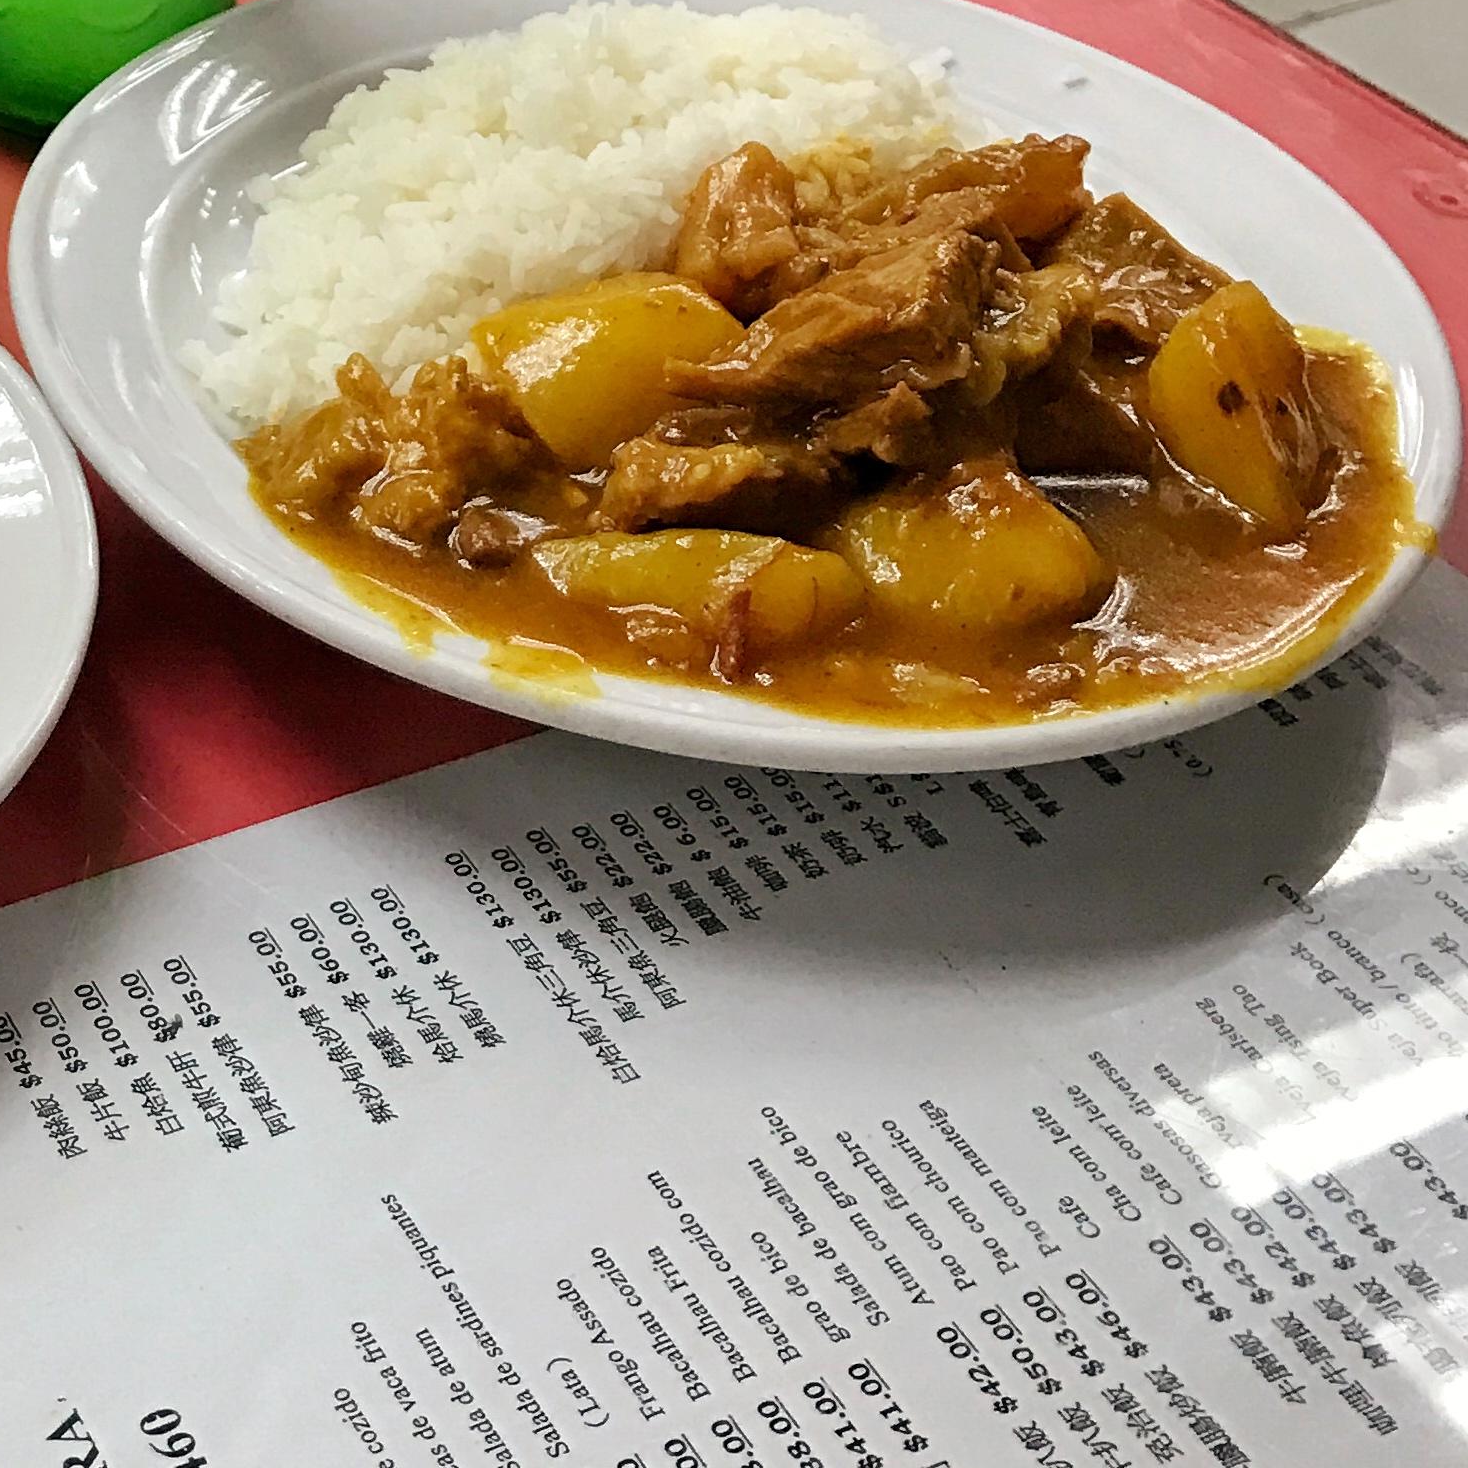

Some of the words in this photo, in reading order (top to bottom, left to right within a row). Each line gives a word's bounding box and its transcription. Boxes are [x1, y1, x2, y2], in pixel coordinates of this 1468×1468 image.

[686, 786, 750, 850] $15.00
[723, 773, 788, 837] $15.00
[525, 826, 588, 894] $55.00
[571, 822, 634, 889] $22.00
[610, 810, 673, 876] $22.00
[444, 850, 515, 929] $130.00
[491, 846, 562, 925] $130.00
[290, 913, 350, 985] $60.00
[329, 897, 398, 980] $130.00
[370, 884, 440, 965] $130.00
[163, 954, 221, 1028] $55.00
[248, 927, 307, 999] $55.00
[32, 997, 89, 1074] $50.00
[74, 980, 139, 1068] $100.00
[75, 1077, 130, 1141] 牛片飯
[1067, 1084, 1107, 1124] leite
[1087, 1050, 1156, 1117] diversas
[1153, 1062, 1205, 1106] preta
[761, 1106, 798, 1146] bico
[793, 1145, 818, 1168] de
[881, 1119, 950, 1193] chourico
[918, 1099, 993, 1177] manteiga
[1031, 1105, 1072, 1145] leite
[1100, 1123, 1143, 1161] com
[647, 1170, 683, 1209] com
[814, 1170, 858, 1209] grao
[835, 1130, 910, 1210] fiambre
[1068, 1144, 1107, 1182] com
[1140, 1163, 1183, 1206] Cafe
[747, 1157, 817, 1238] bacalhau
[947, 1195, 985, 1234] com
[988, 1179, 1027, 1217] com
[1058, 1195, 1101, 1239] Cafe
[1105, 1184, 1142, 1222] Cha
[1272, 1185, 1357, 1271] $43.00
[1311, 1171, 1398, 1254] $43.00
[380, 1194, 455, 1280] piquantes
[679, 1213, 732, 1273] cozido
[750, 1231, 788, 1275] bico
[812, 1237, 837, 1260] de
[849, 1212, 888, 1252] com
[905, 1211, 944, 1251] com
[982, 1237, 1020, 1276] Pao
[1024, 1220, 1062, 1259] Pao
[1189, 1217, 1275, 1305] $43.00
[1230, 1207, 1316, 1289] $42.00
[590, 1246, 643, 1307] cozido
[647, 1245, 689, 1293] Frita
[784, 1274, 810, 1297] de
[833, 1262, 891, 1327] Salada
[884, 1253, 935, 1305] Atum
[940, 1254, 977, 1292] Pao
[1148, 1234, 1233, 1323] $43.00
[350, 1321, 387, 1363] frito
[441, 1281, 504, 1358] sardines
[556, 1278, 615, 1344] Assado
[683, 1292, 758, 1384] Bacalhau
[727, 1275, 803, 1365] Bacalhau
[806, 1300, 852, 1344] grao
[1022, 1285, 1105, 1377] $43.00
[1065, 1268, 1149, 1359] $46.00
[415, 1327, 456, 1377] atum
[497, 1361, 521, 1386] de
[638, 1309, 711, 1402] Bacalhau
[936, 1321, 1018, 1415] $42.00
[979, 1304, 1063, 1396] $50.00
[379, 1365, 417, 1412] vaca
[449, 1380, 474, 1405] de
[608, 1349, 666, 1422] Frango
[848, 1357, 929, 1453] $41.00
[333, 1388, 384, 1455] cozido
[412, 1415, 437, 1441] de
[516, 1388, 570, 1459] Salada
